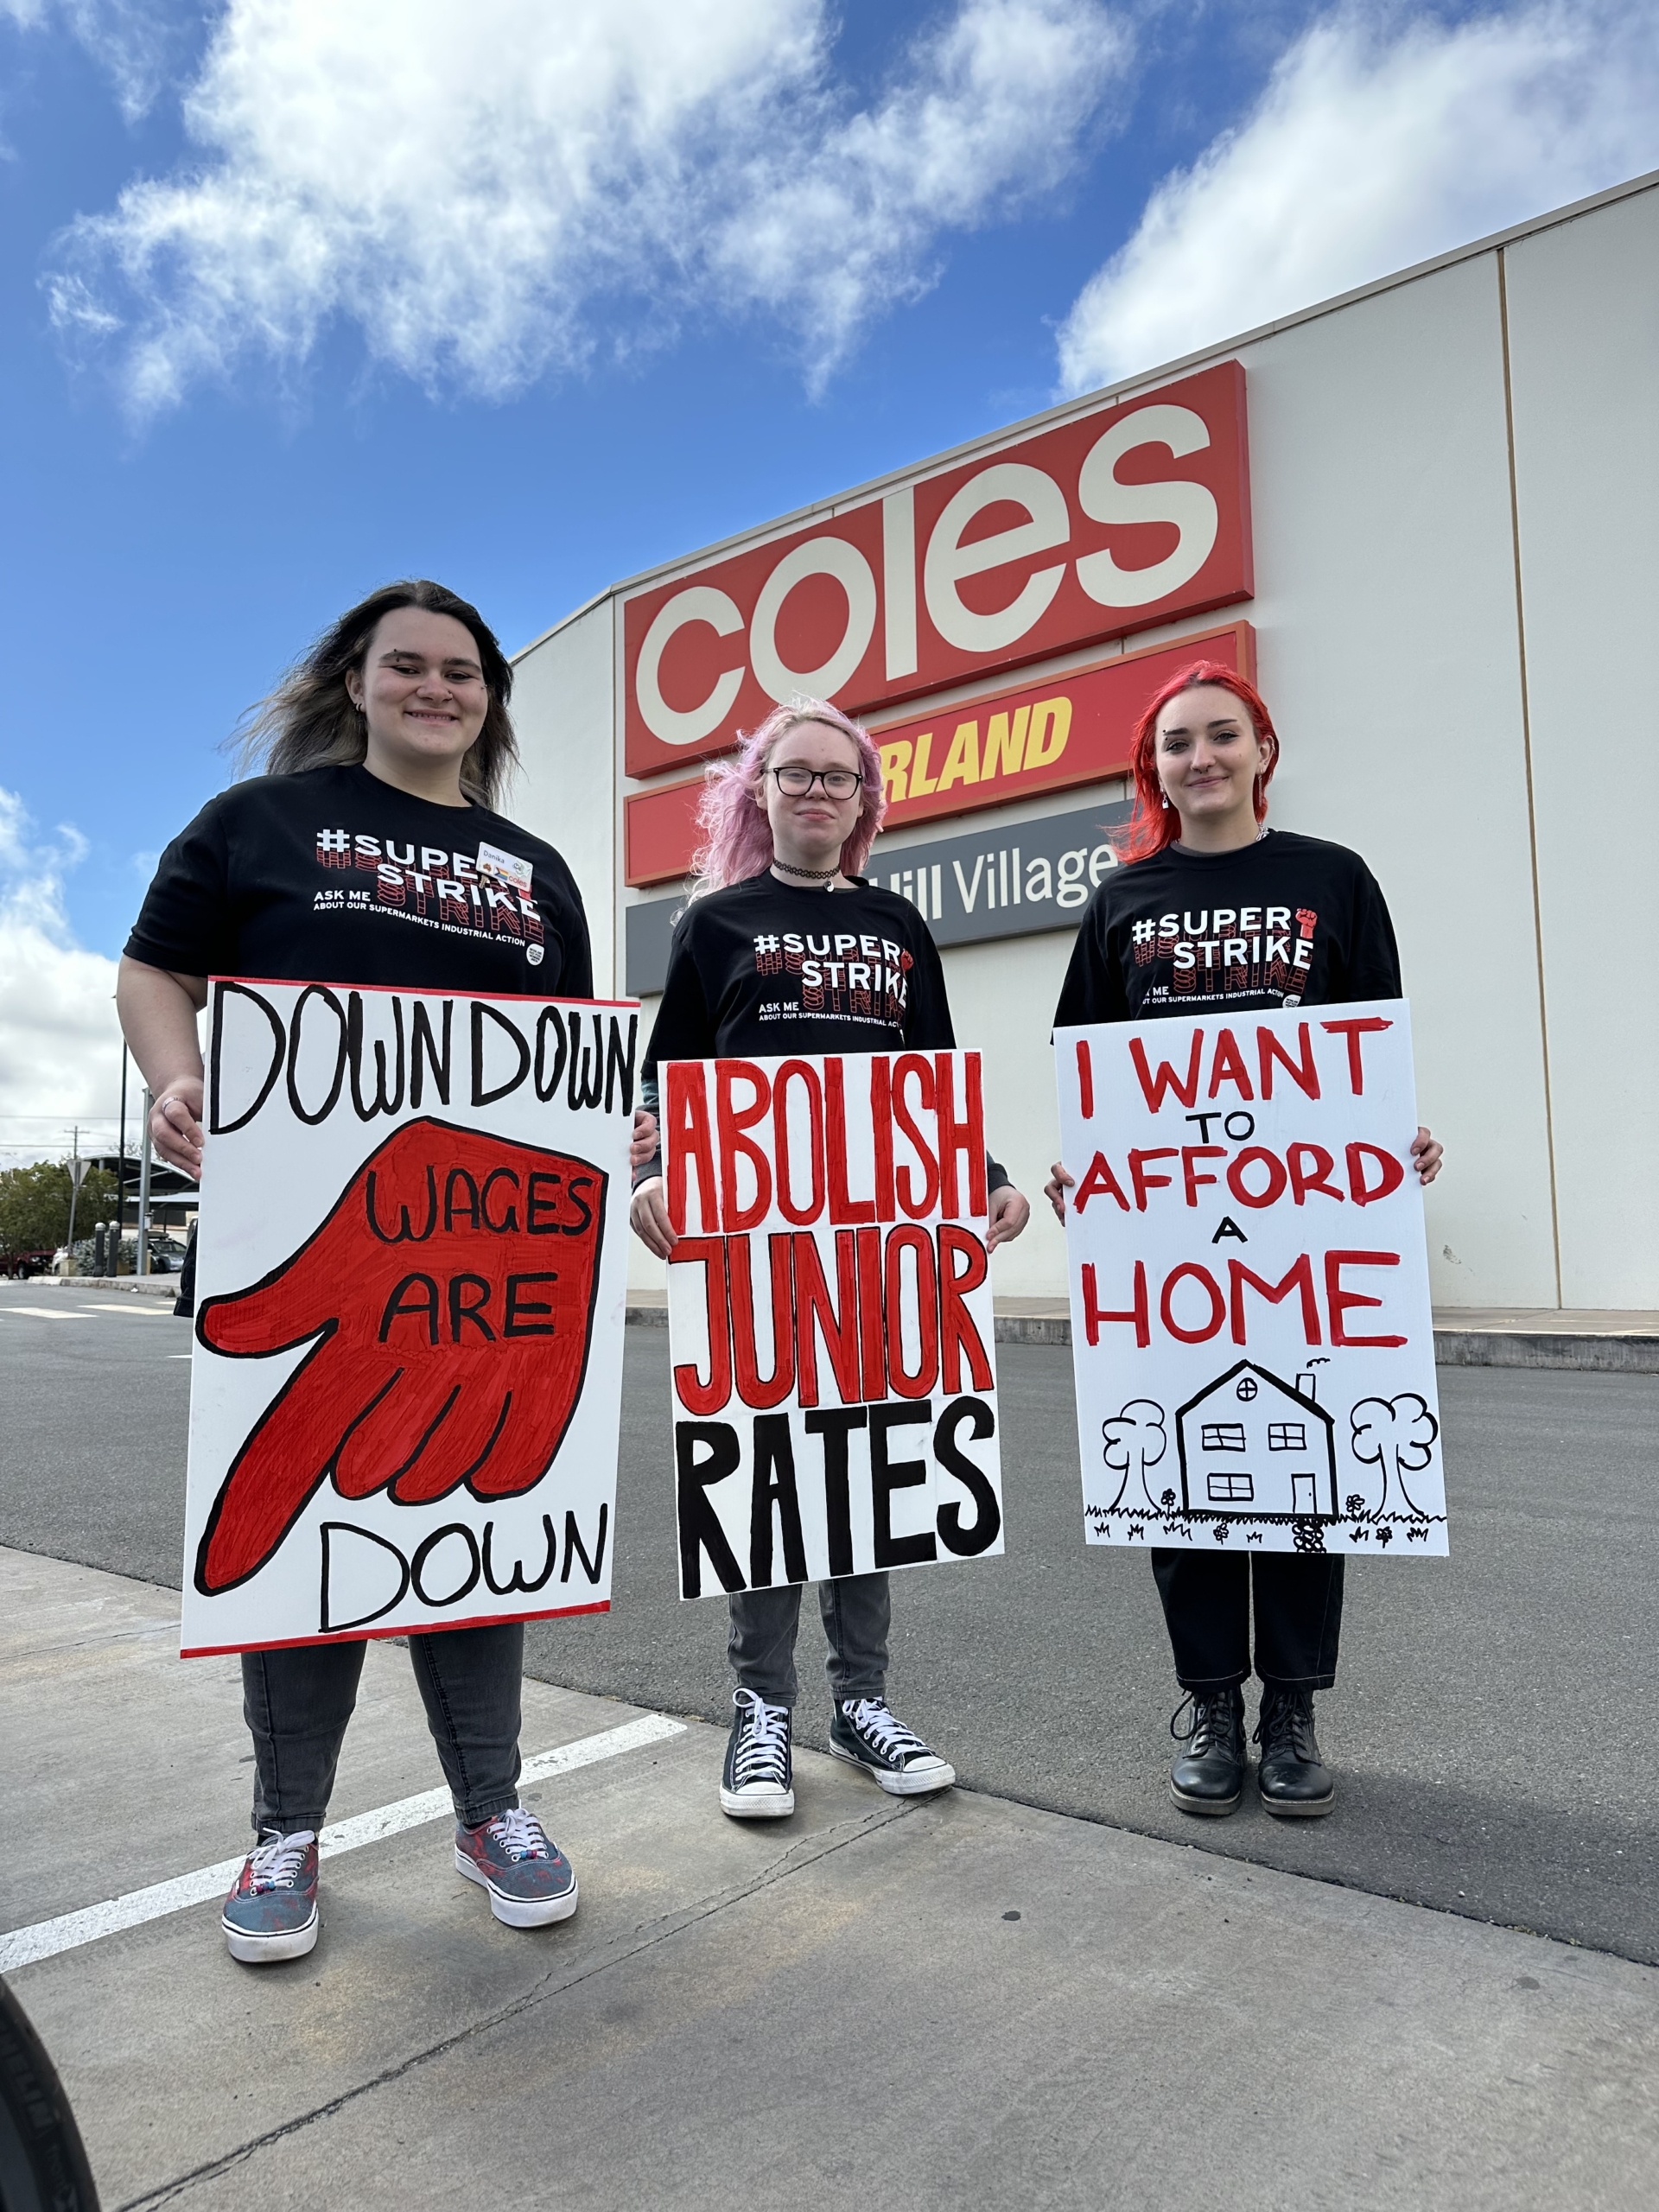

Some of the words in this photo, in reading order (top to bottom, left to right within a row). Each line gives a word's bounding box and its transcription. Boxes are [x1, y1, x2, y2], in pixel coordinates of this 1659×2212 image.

[636, 404, 1218, 745] coles
[879, 696, 1072, 804] RLAND
[316, 829, 508, 888] #SUPE
[483, 850, 505, 864] Danika
[509, 875, 527, 887] coles
[952, 843, 1118, 913] Village
[314, 890, 344, 901] ASK
[349, 890, 371, 901] ME
[377, 863, 541, 922] STRIKE
[314, 902, 344, 911] ABOUT
[346, 901, 366, 910] OUR
[369, 904, 440, 929] SUPERMARKETS
[442, 923, 493, 940] INDUSTRIAL
[496, 934, 525, 947] ACTION
[753, 933, 900, 967] #SUPER
[1132, 906, 1292, 944] #SUPER
[1173, 936, 1314, 970] STRIKE
[759, 1002, 780, 1013] ASK
[783, 1001, 799, 1011] ME
[798, 1012, 851, 1021] SUPERMARKETS
[852, 1015, 887, 1026] INDUSTRIAL
[1153, 986, 1169, 996] ME
[1168, 993, 1224, 1002] SUPERMARKETS
[1225, 988, 1265, 999] INDUSTRIAL
[1076, 1039, 1093, 1119] I
[1128, 1016, 1394, 1114] WANT
[666, 1052, 987, 1236] ABOLISH
[1185, 1111, 1255, 1144] TO
[366, 1164, 593, 1243] WAGES
[1073, 1142, 1404, 1214] AFFORD
[1211, 1216, 1248, 1243] A
[378, 1272, 558, 1344] ARE
[668, 1224, 995, 1417] JUNIOR
[1082, 1249, 1408, 1348] HOME
[675, 1395, 1001, 1599] RATES
[319, 1503, 608, 1632] DOWN
